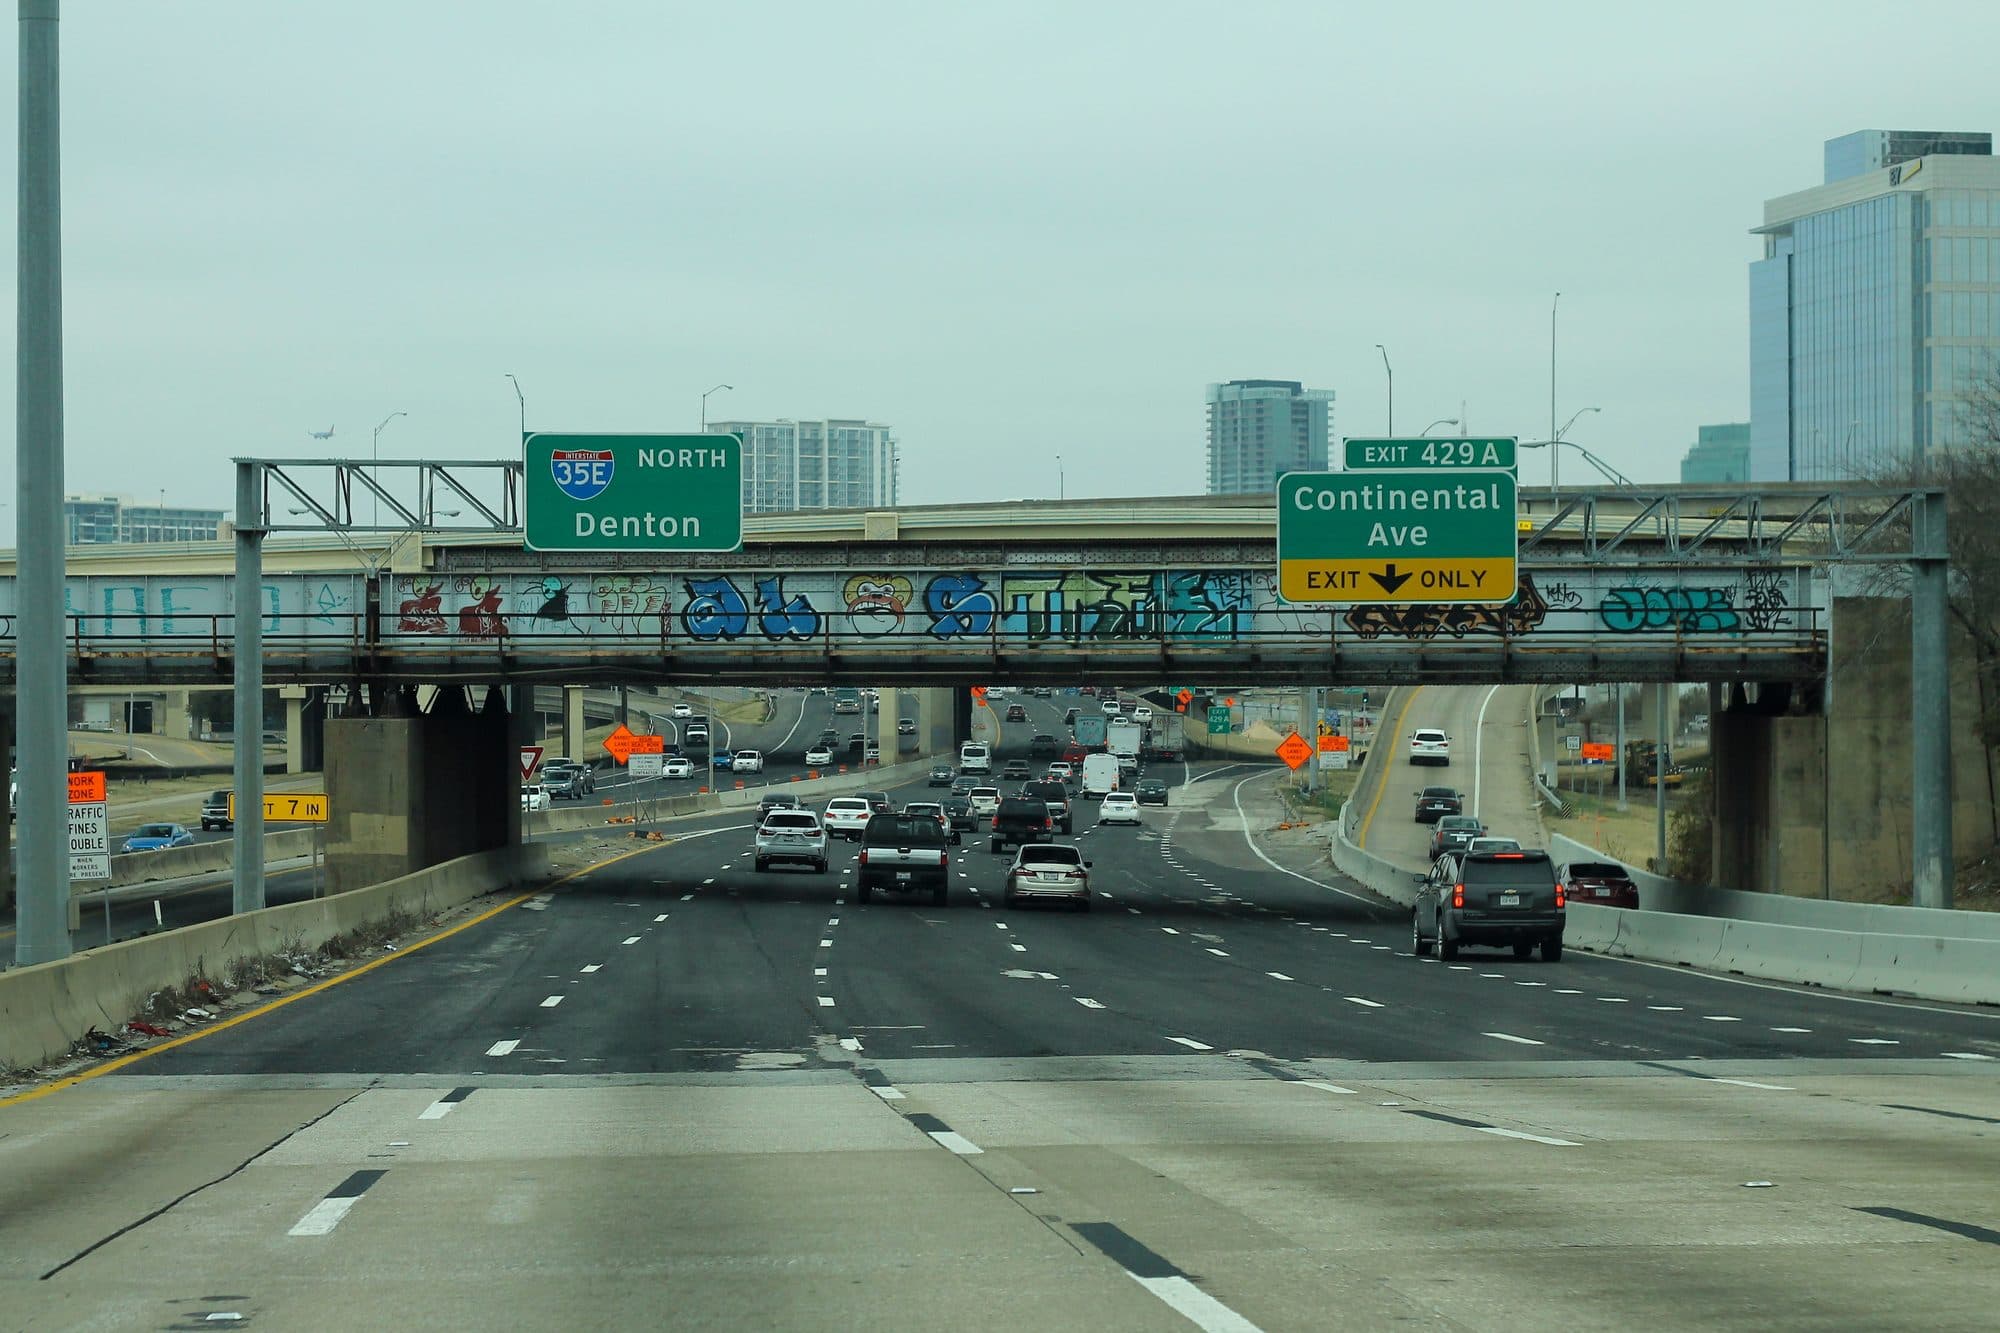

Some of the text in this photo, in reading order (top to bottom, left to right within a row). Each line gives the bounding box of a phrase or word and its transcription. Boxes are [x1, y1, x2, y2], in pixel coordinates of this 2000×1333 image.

[638, 449, 726, 467] NORTH
[1365, 446, 1408, 462] EXIT
[557, 462, 606, 486] 35E
[1295, 483, 1501, 511] Continental
[575, 512, 700, 537] Denton
[1367, 522, 1428, 546] Ave
[1308, 570, 1487, 589] EXIT ONLY
[68, 789, 95, 800] ZONE
[68, 807, 103, 820] RAFFIC
[288, 800, 299, 815] 7
[306, 804, 319, 816] IN
[68, 823, 97, 835] FINES
[71, 838, 104, 850] OUBLE
